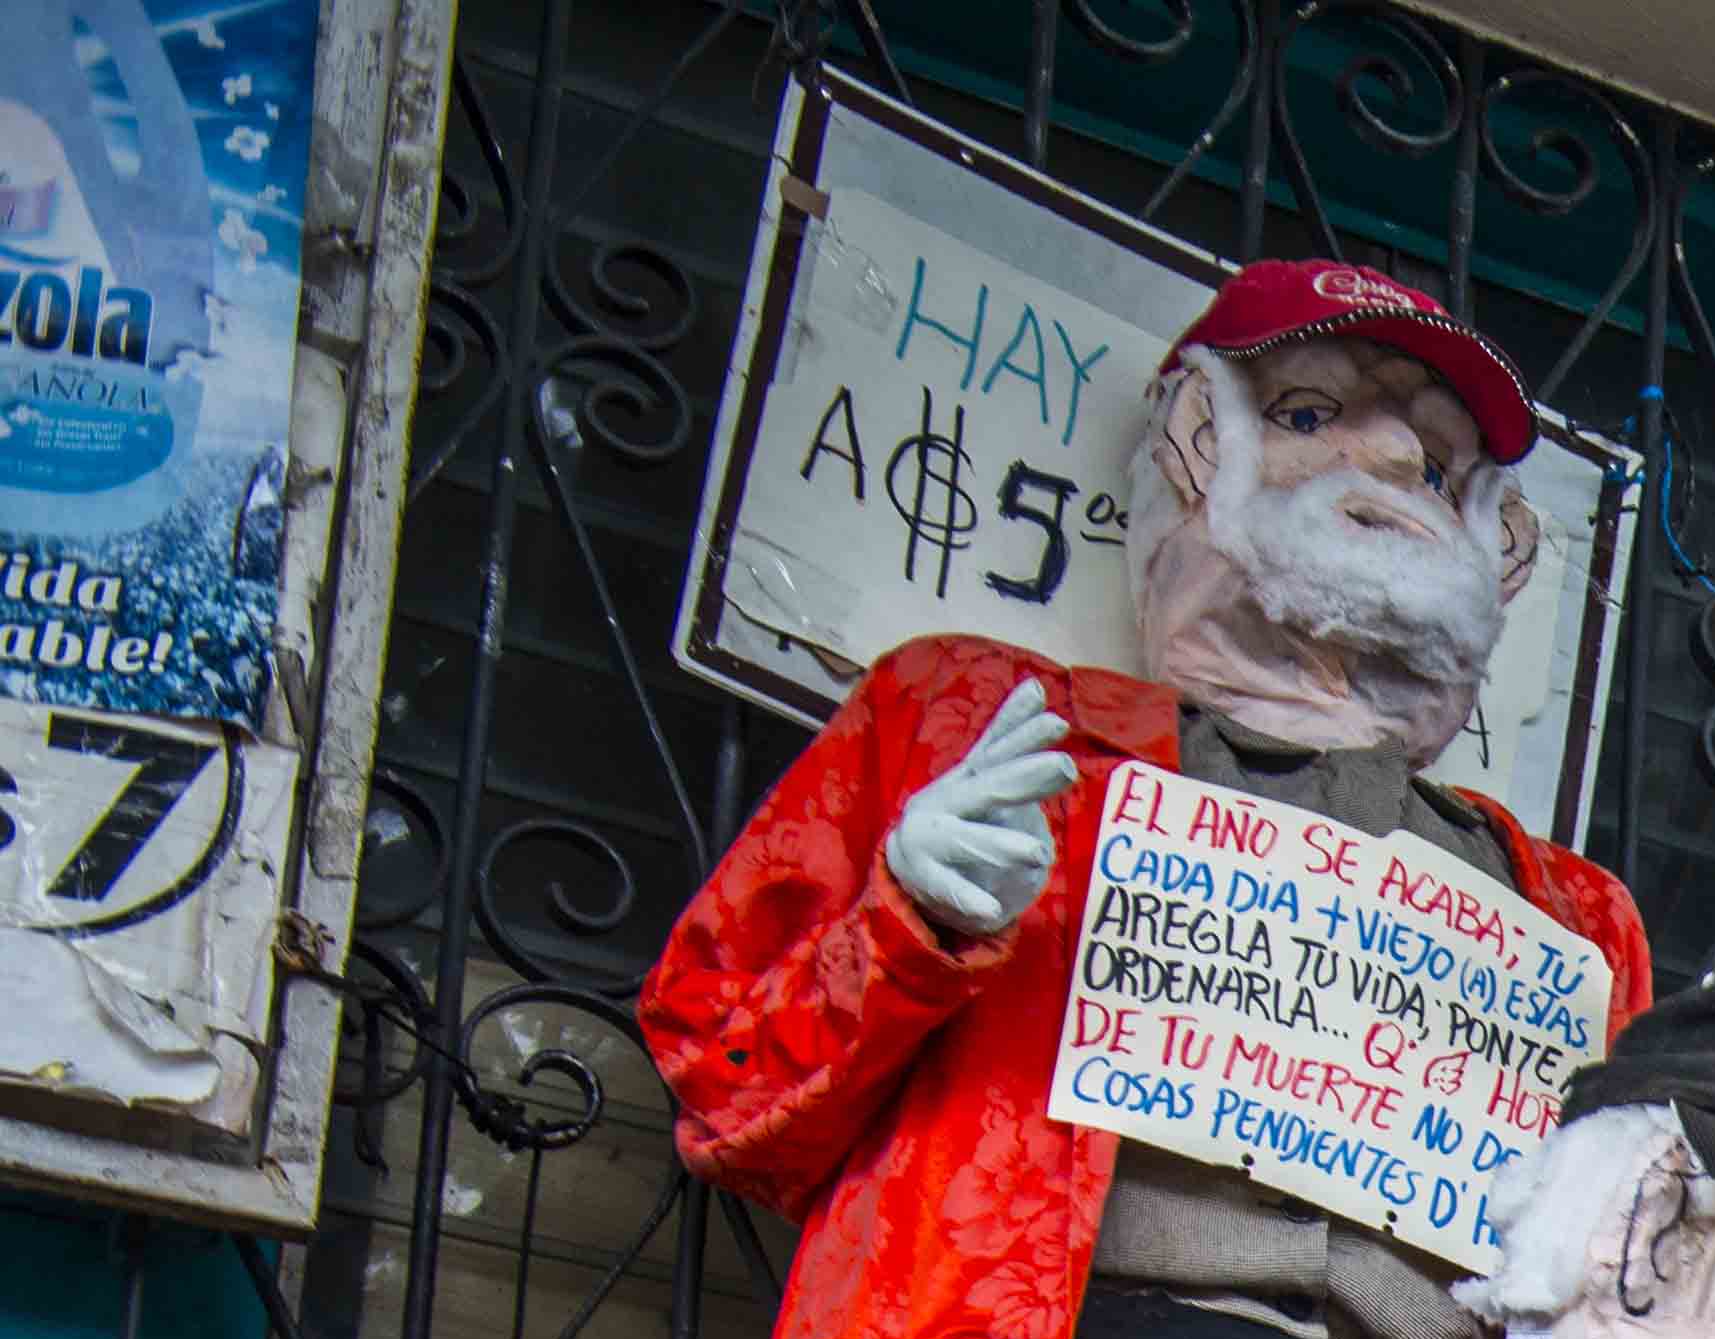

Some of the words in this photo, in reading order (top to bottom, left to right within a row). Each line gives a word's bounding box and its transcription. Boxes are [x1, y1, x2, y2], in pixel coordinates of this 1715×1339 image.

[895, 257, 1110, 447] HAY
[800, 386, 866, 502] A
[1100, 833, 1214, 903] CADA
[1112, 767, 1170, 838] EL
[1188, 800, 1279, 858] AÑO
[1303, 824, 1361, 885] SE
[1536, 942, 1591, 995] TÚ
[1091, 885, 1273, 967] AREGLA
[1291, 936, 1340, 990] TU
[1450, 1002, 1565, 1094] PONTE
[1070, 996, 1144, 1055] DE
[1159, 1015, 1215, 1073] TU
[1222, 1032, 1406, 1131] MUERTE
[1411, 1104, 1464, 1157] NO
[1072, 1056, 1194, 1122] COSAS
